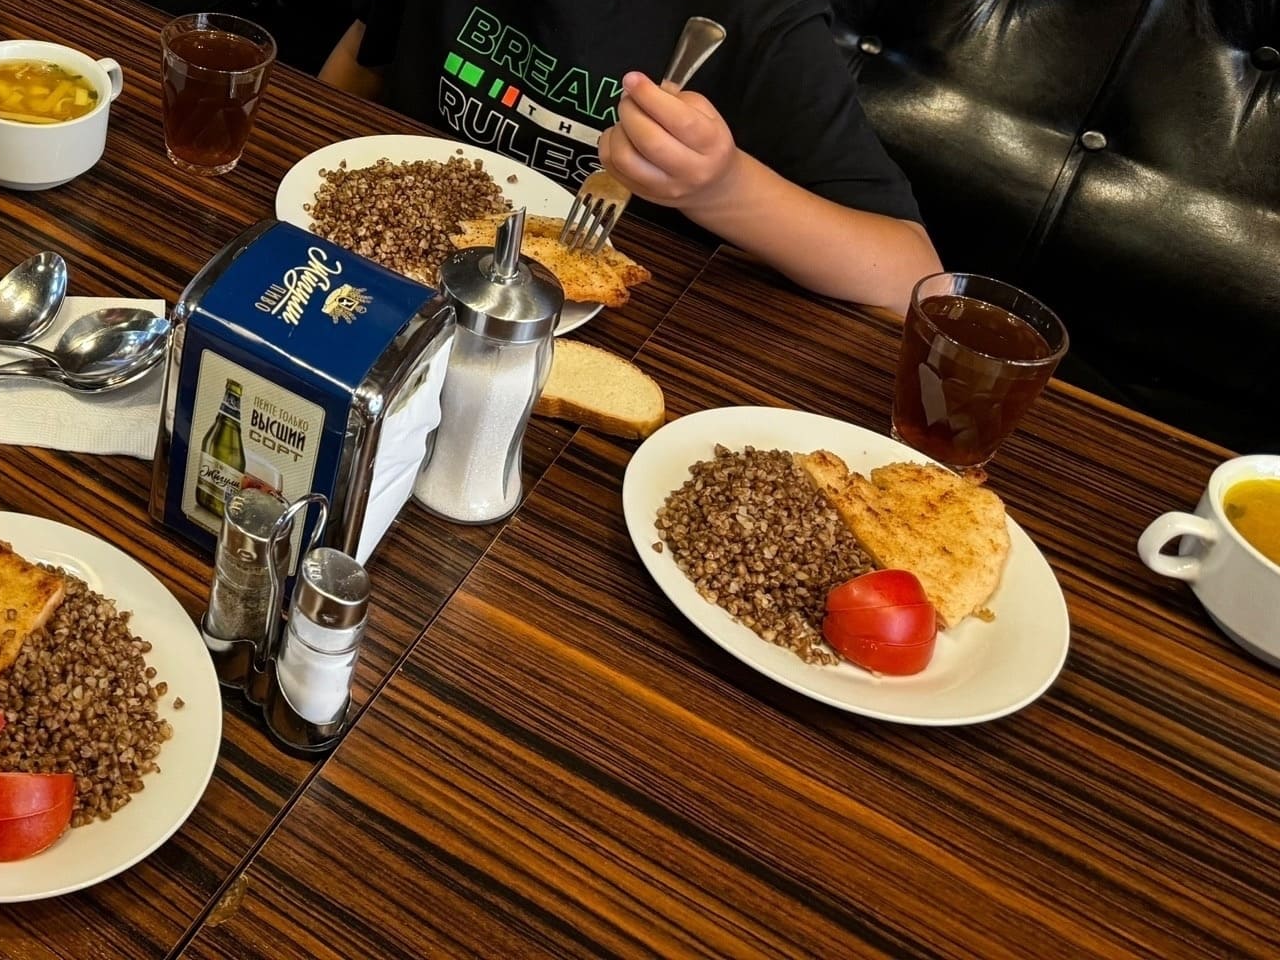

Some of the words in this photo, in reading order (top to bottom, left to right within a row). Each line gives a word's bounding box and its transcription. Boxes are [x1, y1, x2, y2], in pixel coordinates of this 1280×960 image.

[457, 6, 624, 124] BREAK
[527, 103, 602, 146] TH
[254, 283, 287, 312] ПИВО
[272, 246, 342, 326] Жигули
[251, 408, 306, 452] ВЫСШИЙ
[279, 408, 309, 432] ТОЛЬКО
[249, 429, 303, 462] СОРТ
